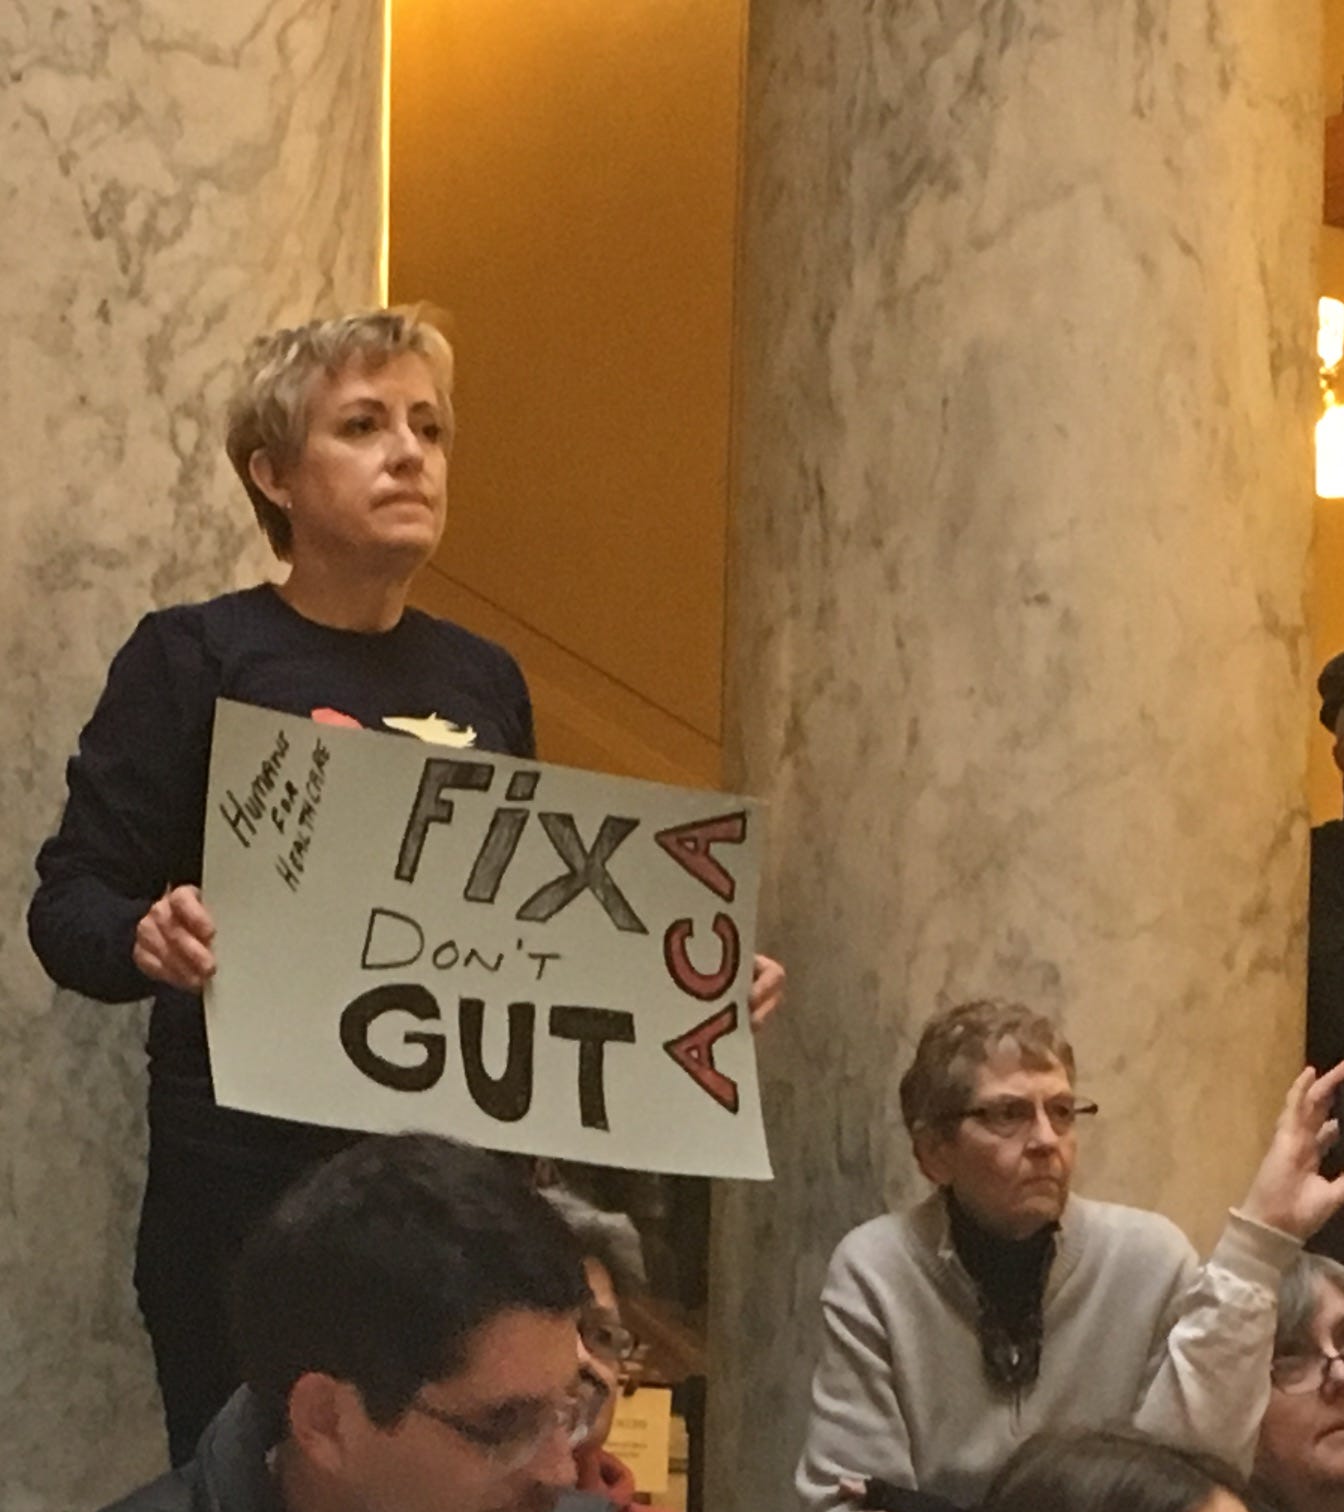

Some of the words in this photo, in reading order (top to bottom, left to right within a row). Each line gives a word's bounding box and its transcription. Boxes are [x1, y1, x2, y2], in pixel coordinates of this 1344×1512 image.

[219, 729, 290, 849] HUMANS
[271, 780, 299, 834] FOR
[275, 736, 331, 893] HEALTHCARE
[654, 808, 749, 1115] ACA
[338, 982, 637, 1133] GUT
